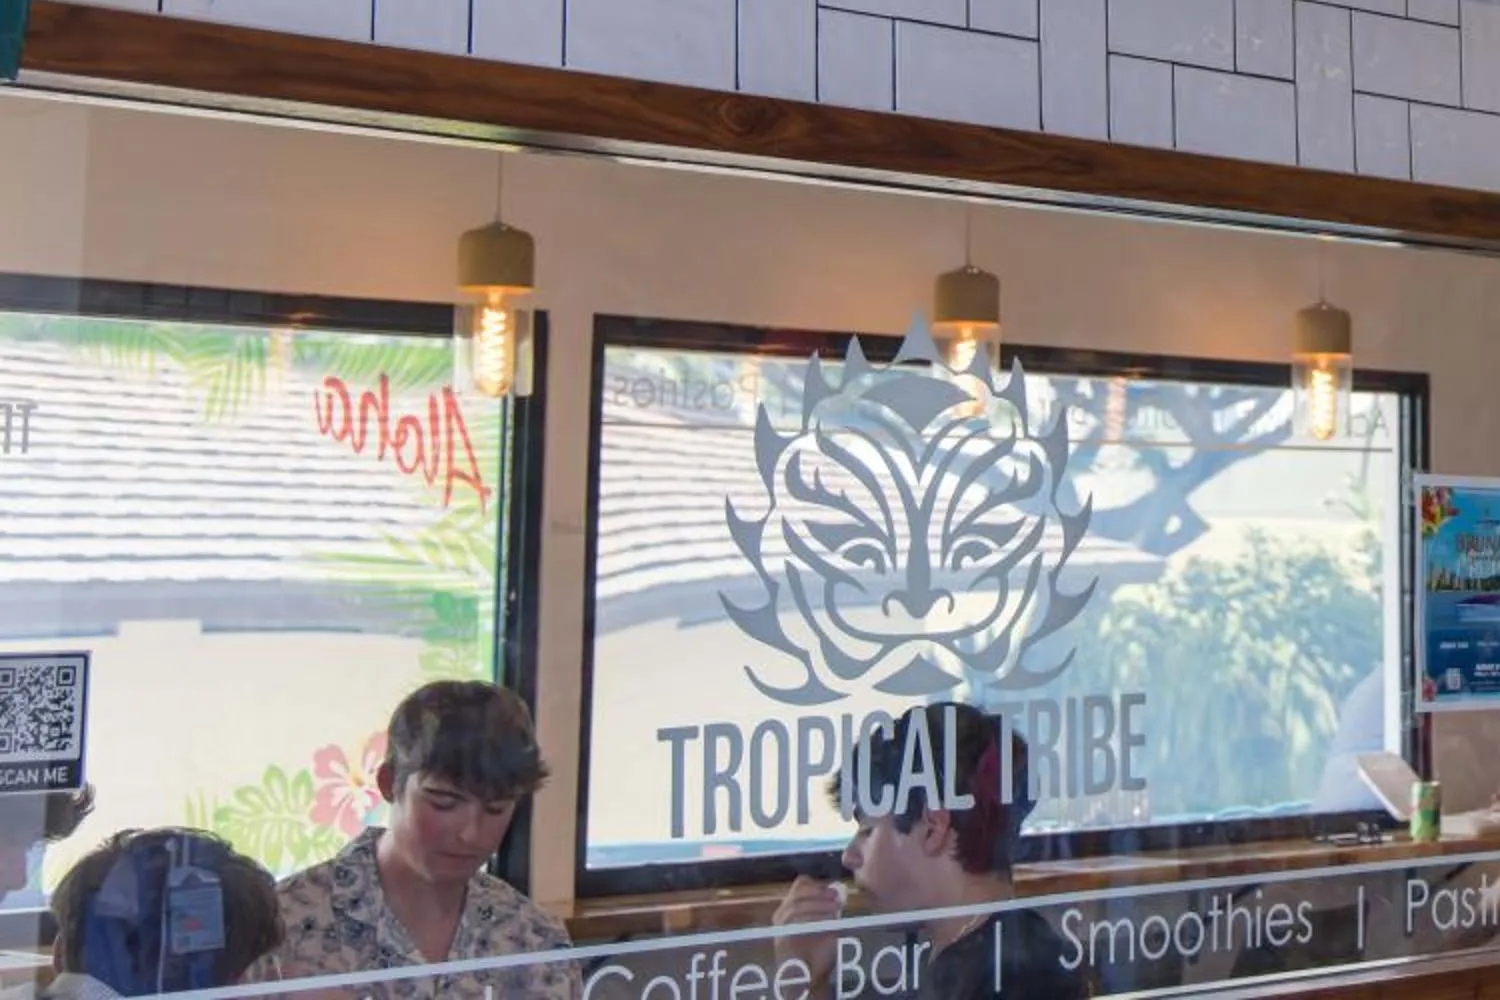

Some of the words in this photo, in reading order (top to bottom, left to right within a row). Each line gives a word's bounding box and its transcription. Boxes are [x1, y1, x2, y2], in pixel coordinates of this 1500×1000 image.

[44, 766, 69, 783] ME
[656, 706, 976, 838] TROPICAL
[988, 694, 1147, 805] TRIBE
[584, 950, 811, 1000] Coffee
[836, 938, 931, 998] Bar
[1059, 890, 1313, 970] Smoothies
